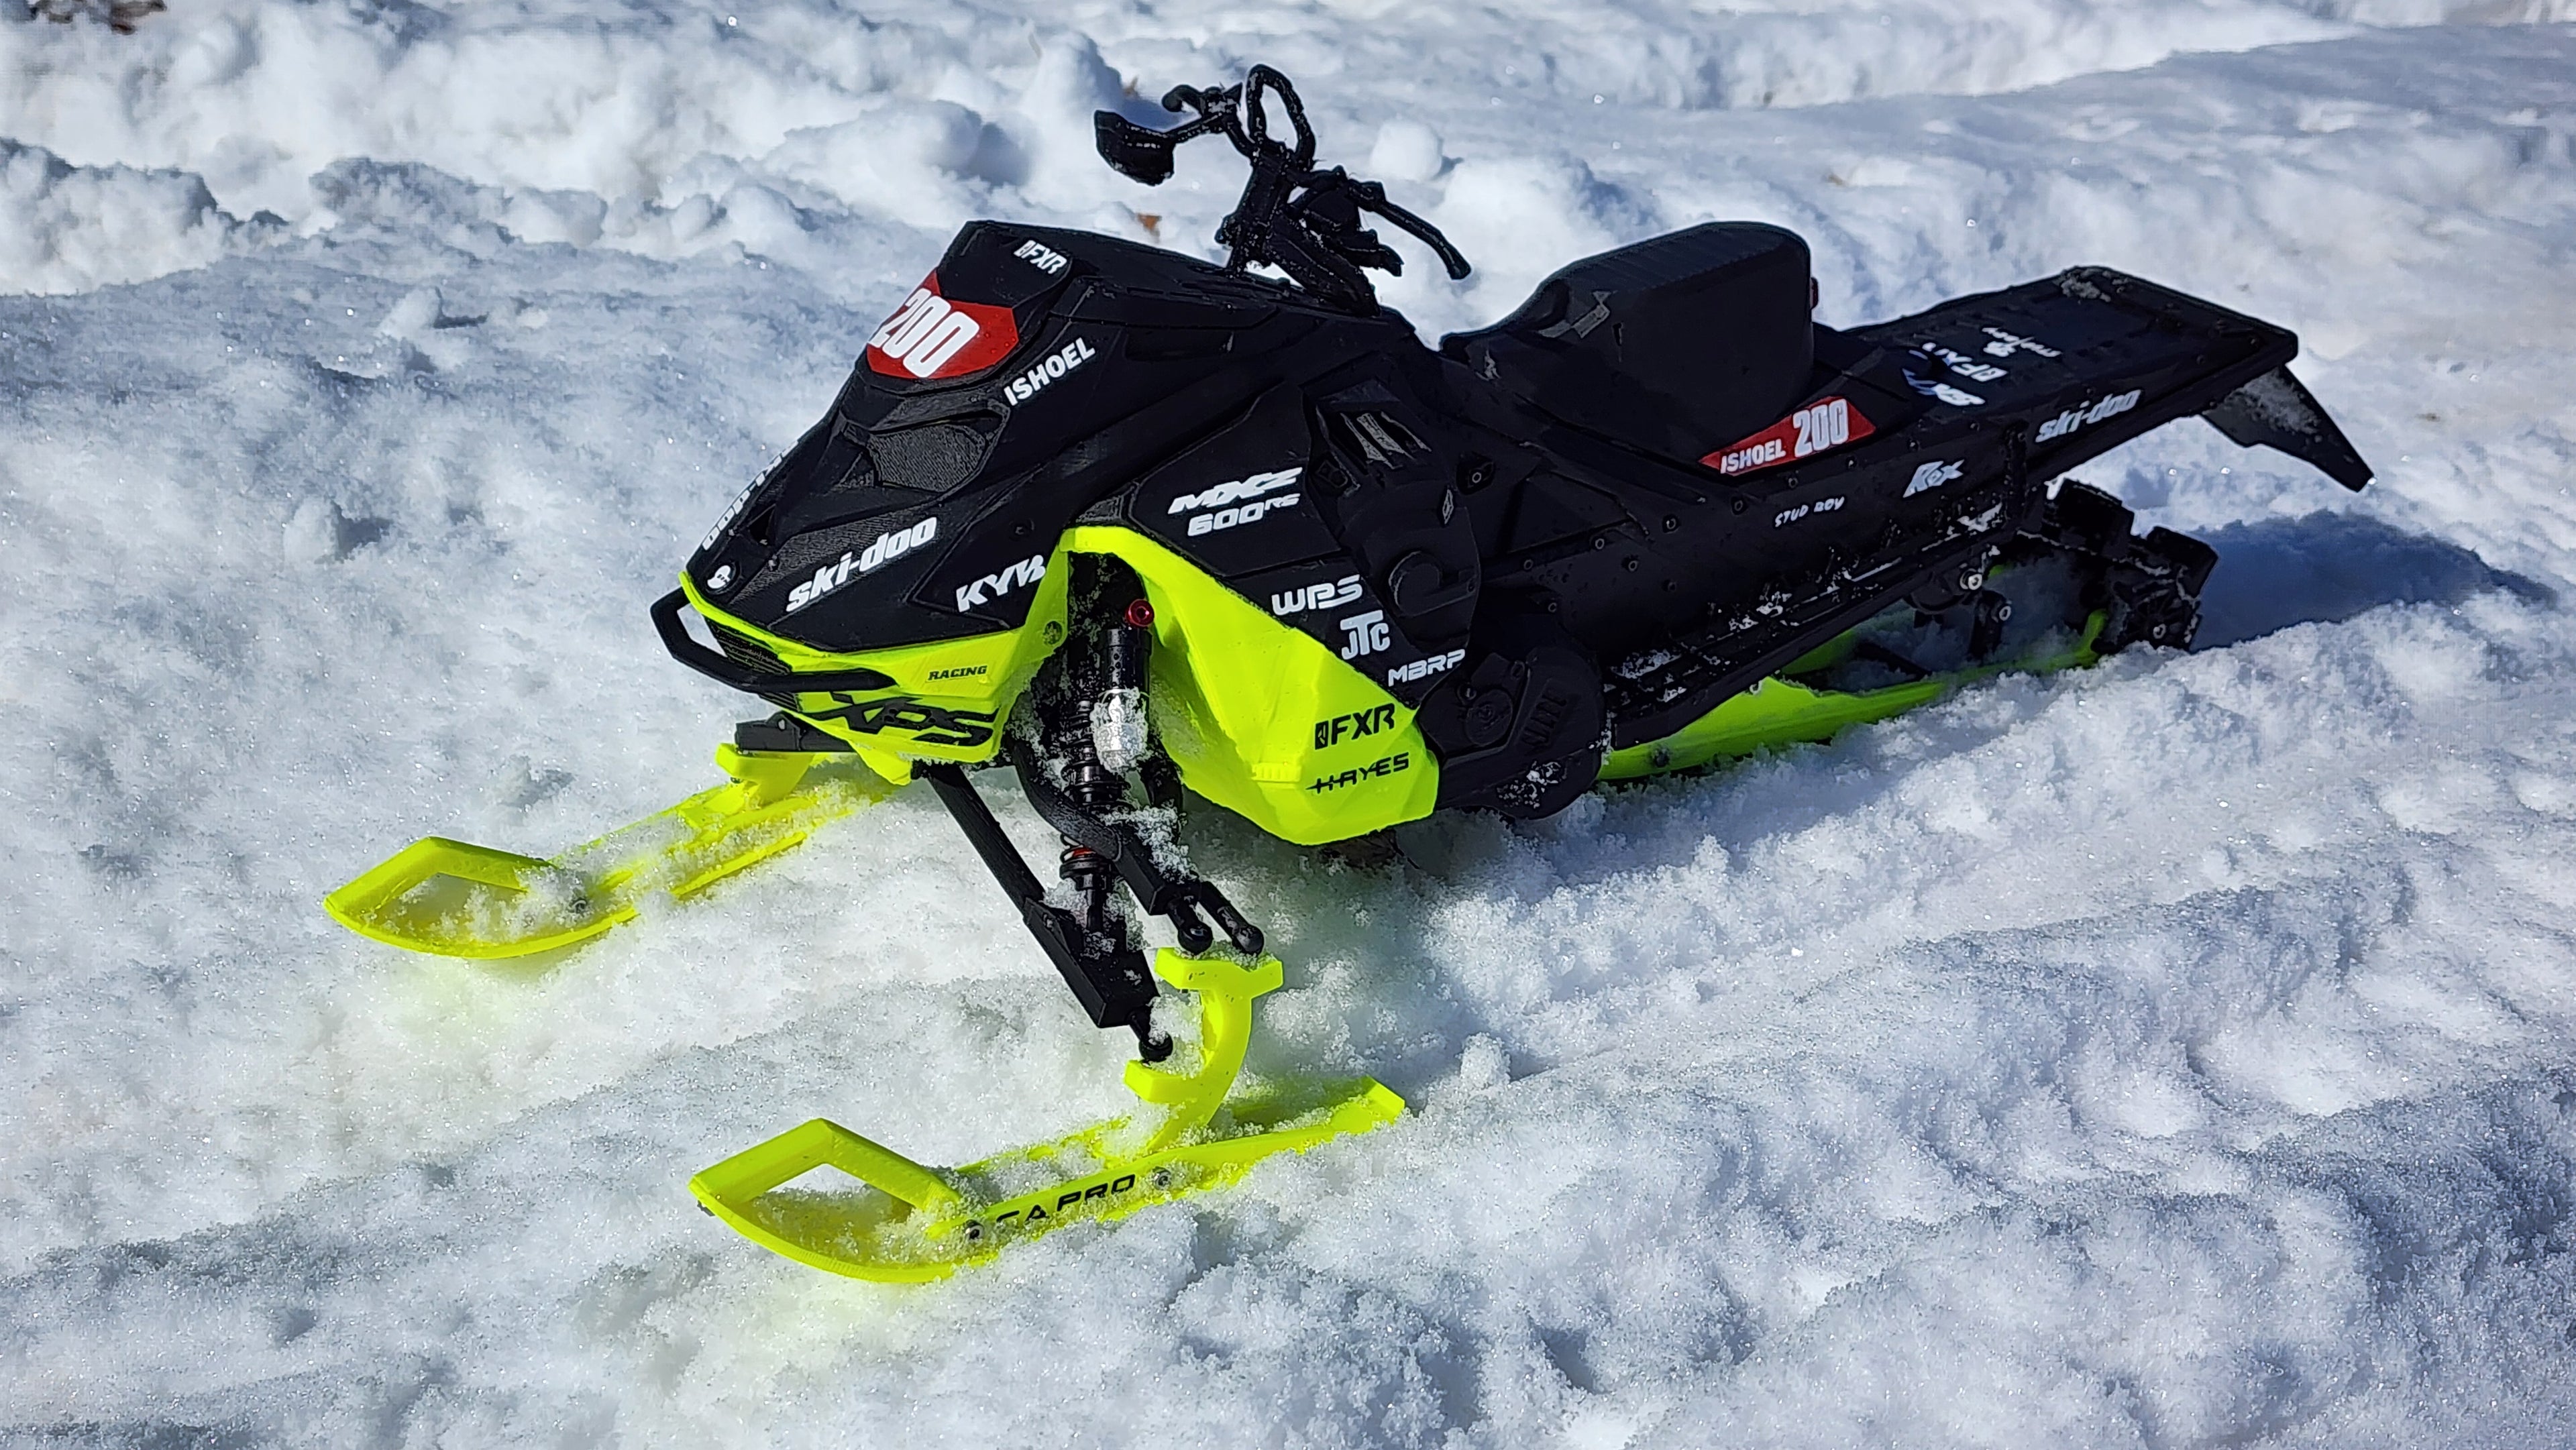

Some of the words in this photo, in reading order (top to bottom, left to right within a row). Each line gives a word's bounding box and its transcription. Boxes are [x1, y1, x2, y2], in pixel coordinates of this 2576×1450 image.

[868, 288, 980, 378] 200
[1004, 337, 1095, 406] ISHOEL
[1720, 438, 1786, 474] ISHOEL
[1792, 399, 1849, 458] 200
[1775, 504, 1809, 527] STUD
[1814, 496, 1845, 512] BOY
[786, 516, 938, 612] ski-doo
[955, 555, 1046, 613] KYB
[1272, 574, 1362, 616] WPS
[1340, 610, 1391, 660] JTC
[927, 665, 987, 681] RACING
[1388, 649, 1466, 687] MBRP
[1331, 703, 1395, 746] FXR
[1305, 752, 1409, 794] HAYES
